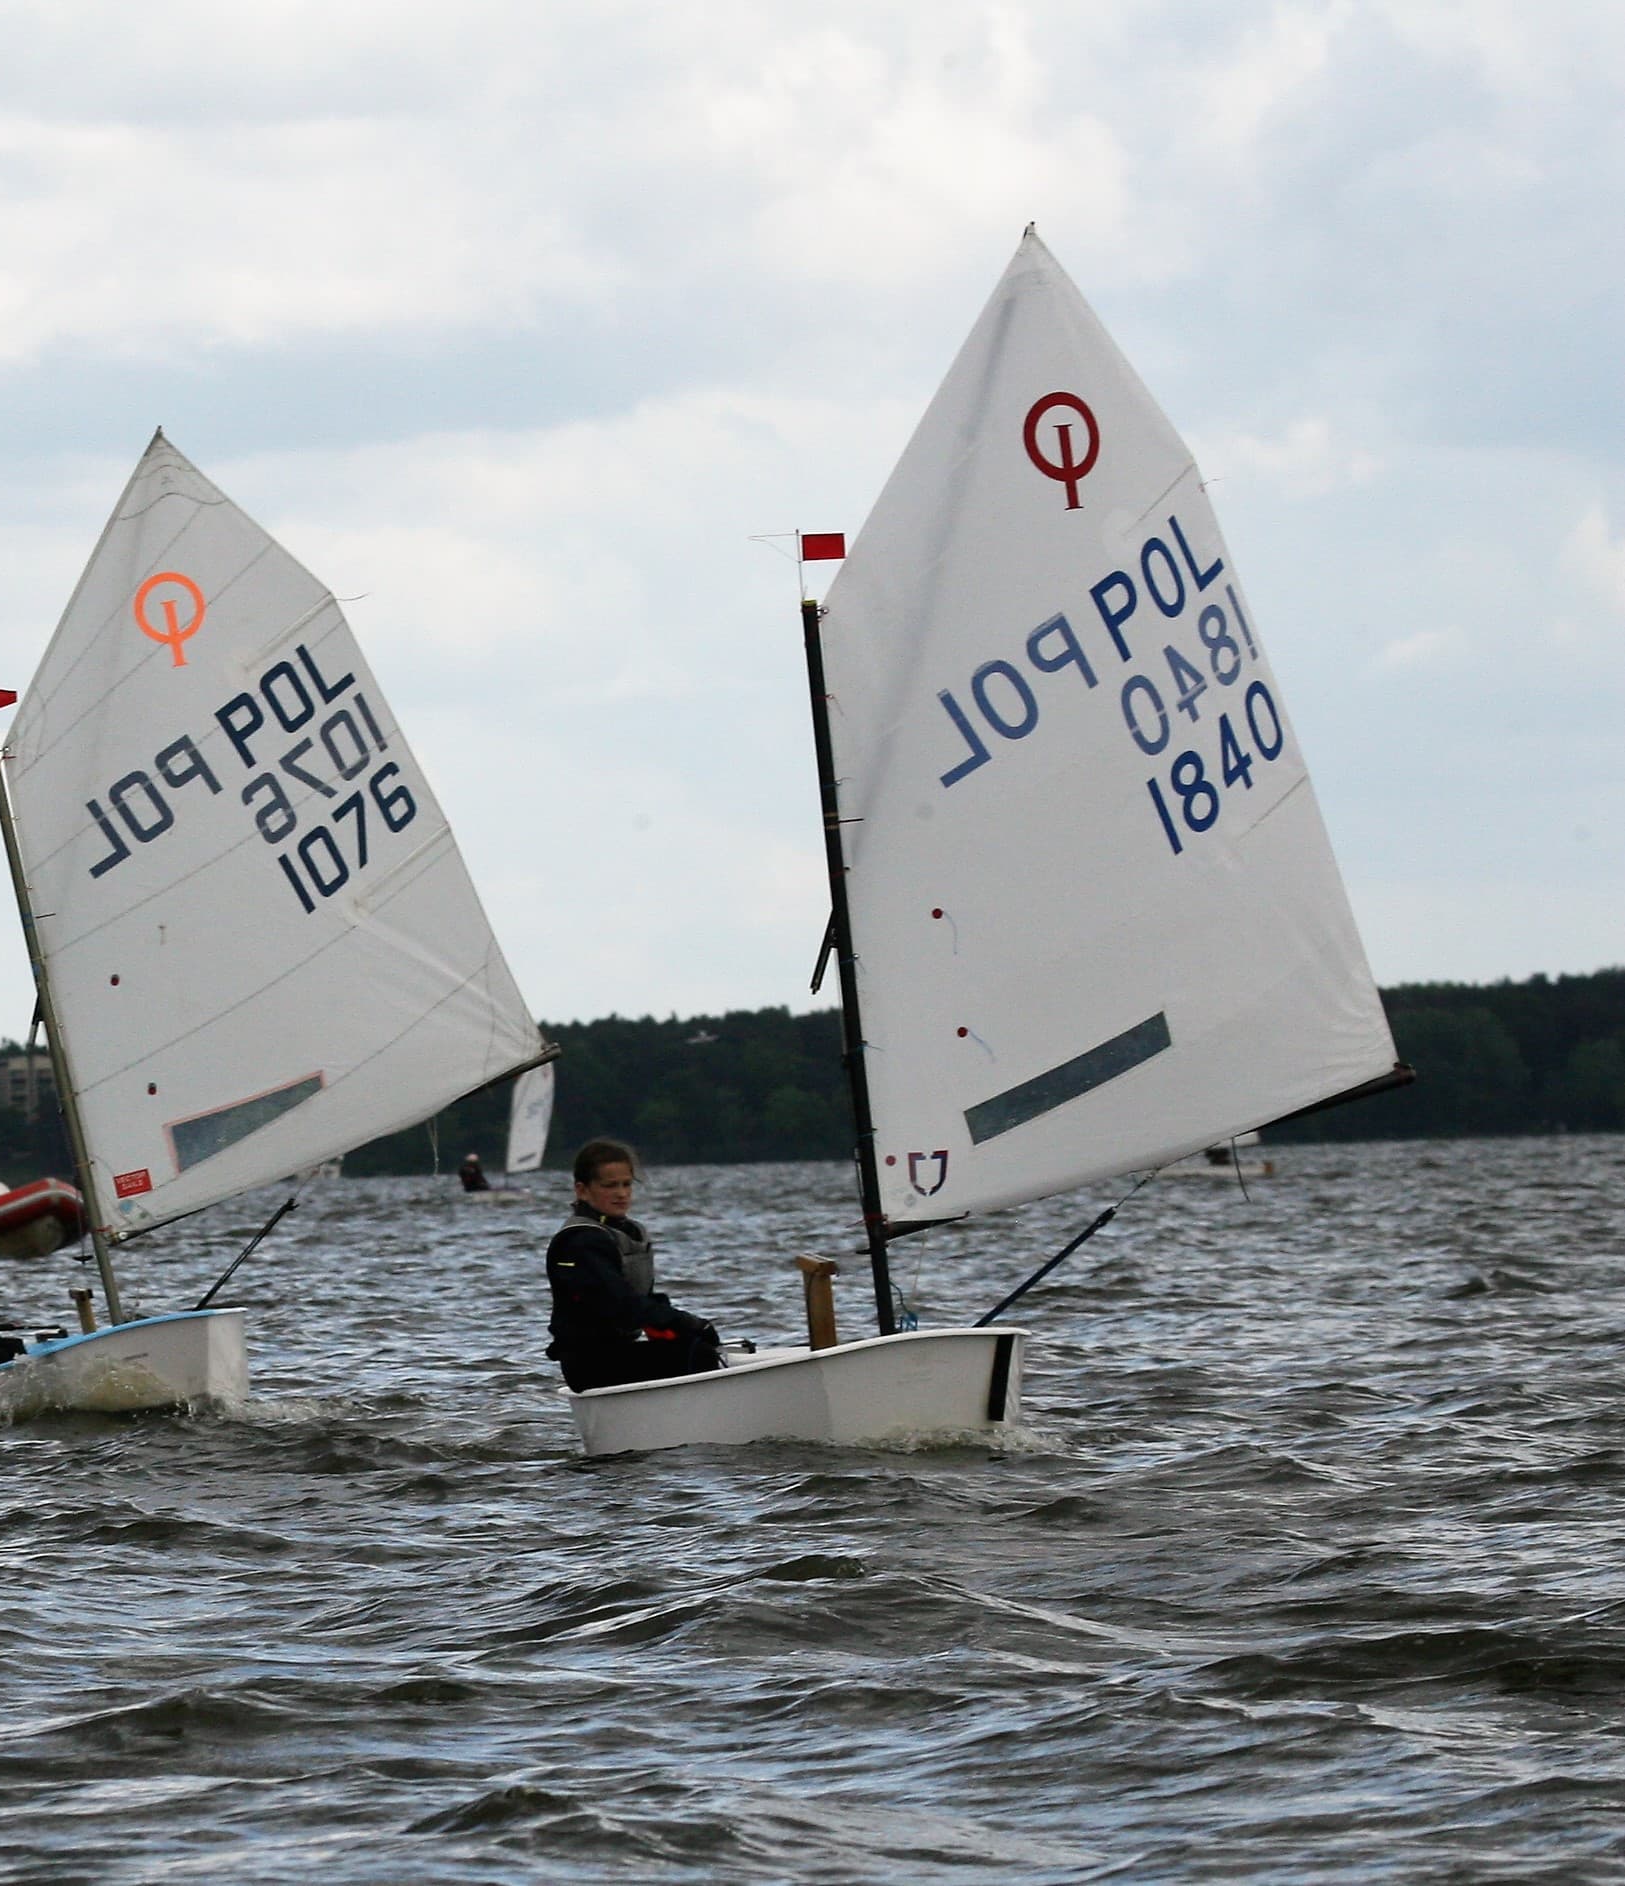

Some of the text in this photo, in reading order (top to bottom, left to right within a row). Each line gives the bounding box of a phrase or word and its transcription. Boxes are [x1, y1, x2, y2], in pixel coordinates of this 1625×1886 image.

[1089, 515, 1224, 663] POL
[214, 644, 356, 769] POL
[1146, 680, 1283, 856] 1840
[278, 761, 417, 915] 1076
